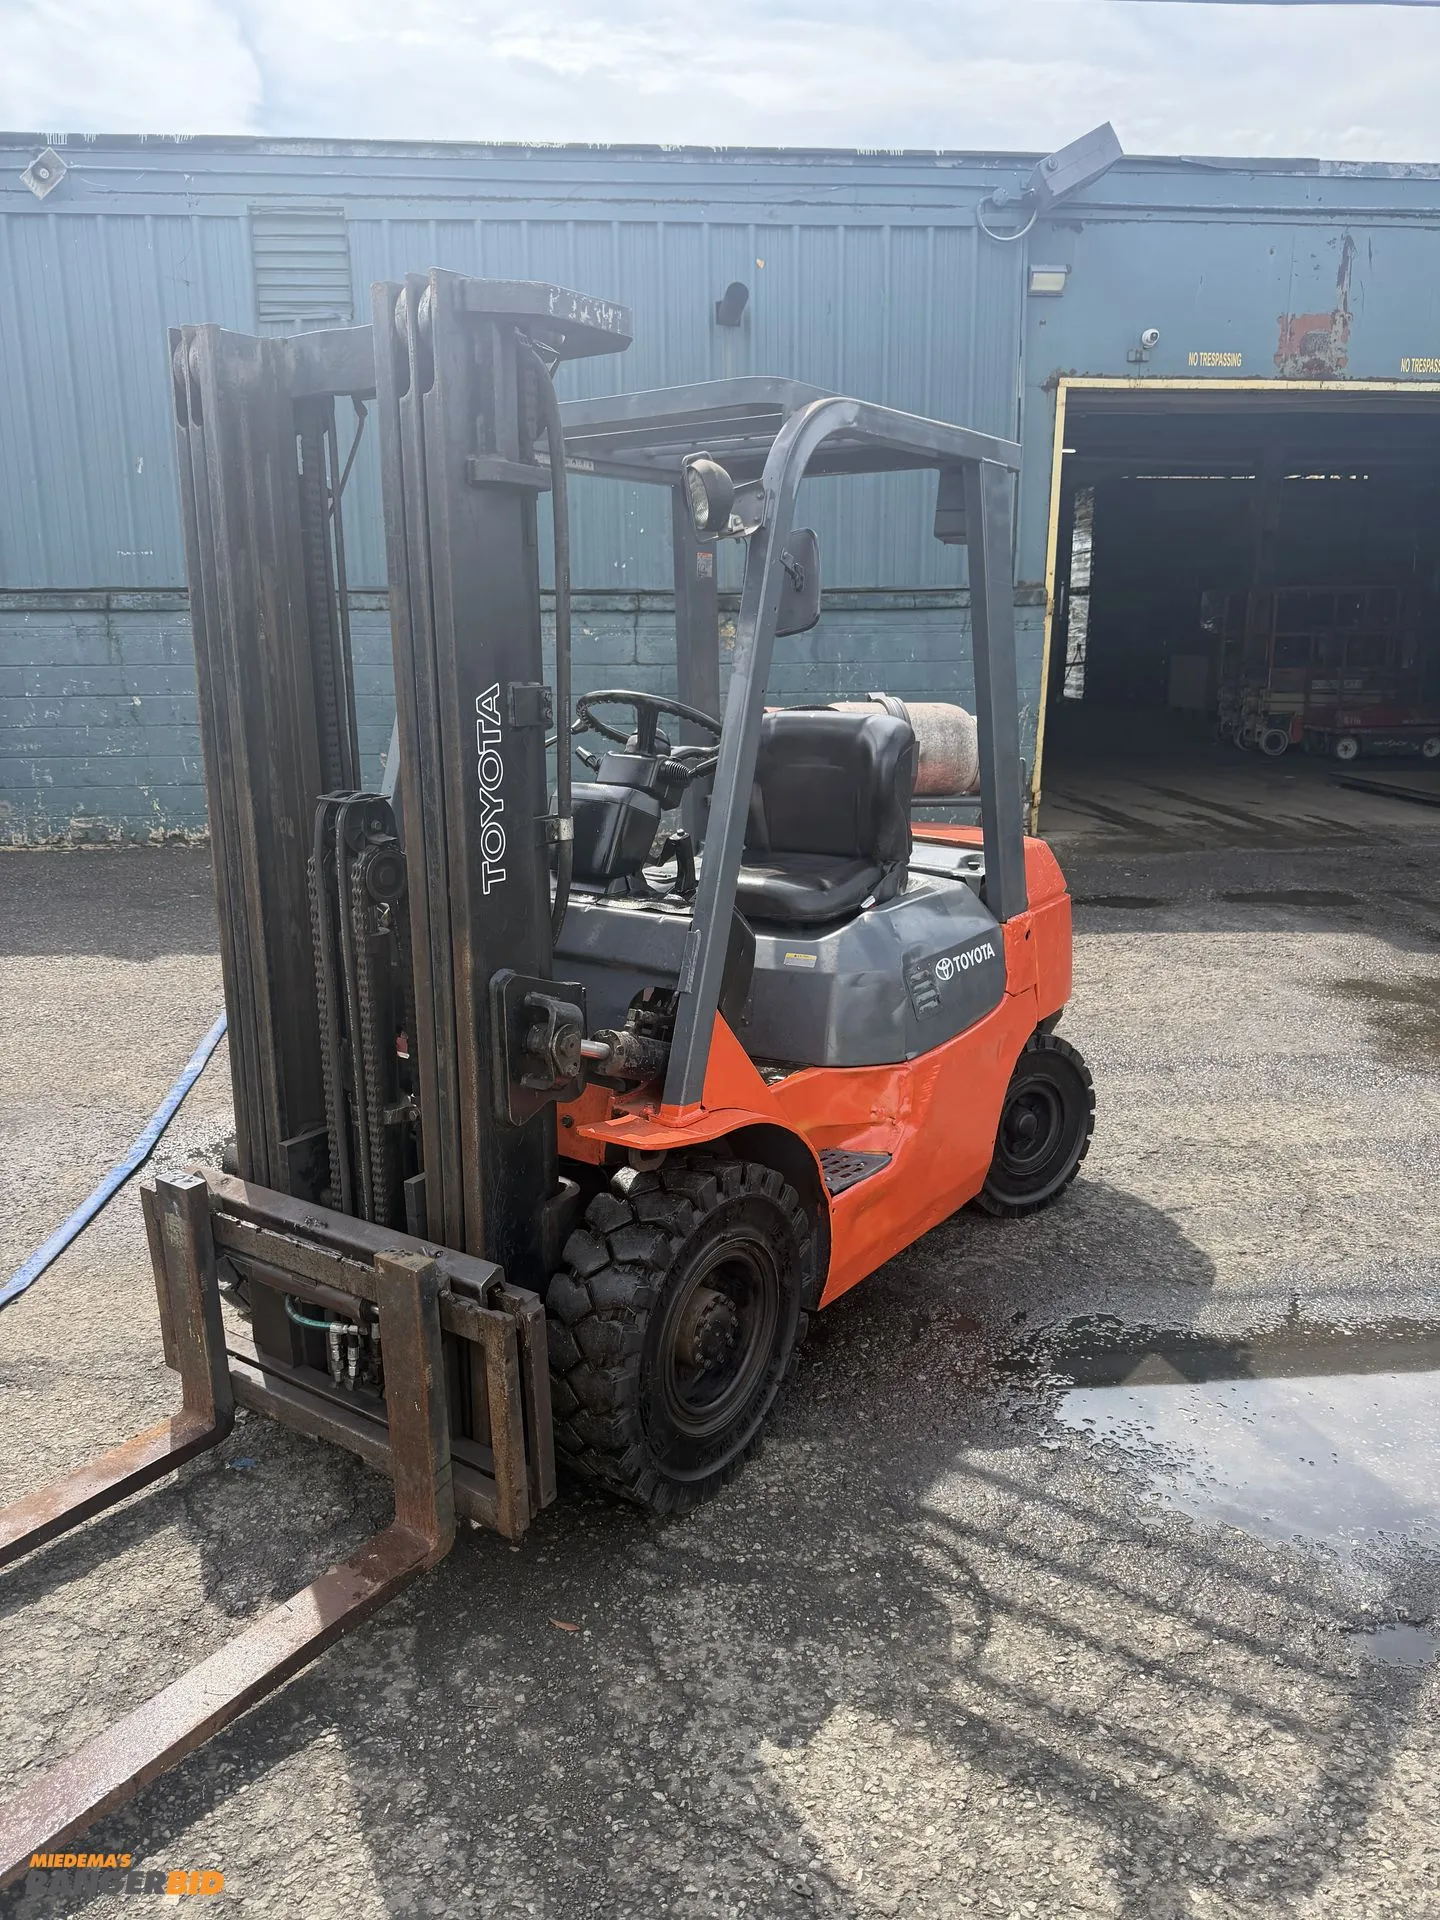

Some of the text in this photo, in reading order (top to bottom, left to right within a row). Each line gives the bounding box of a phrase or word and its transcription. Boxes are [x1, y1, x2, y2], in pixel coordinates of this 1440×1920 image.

[1188, 351, 1242, 368] NO TRESPASSING
[1401, 357, 1440, 373] NO TRESPAS
[476, 682, 506, 895] TOYOTA
[953, 942, 995, 972] TOYOTA
